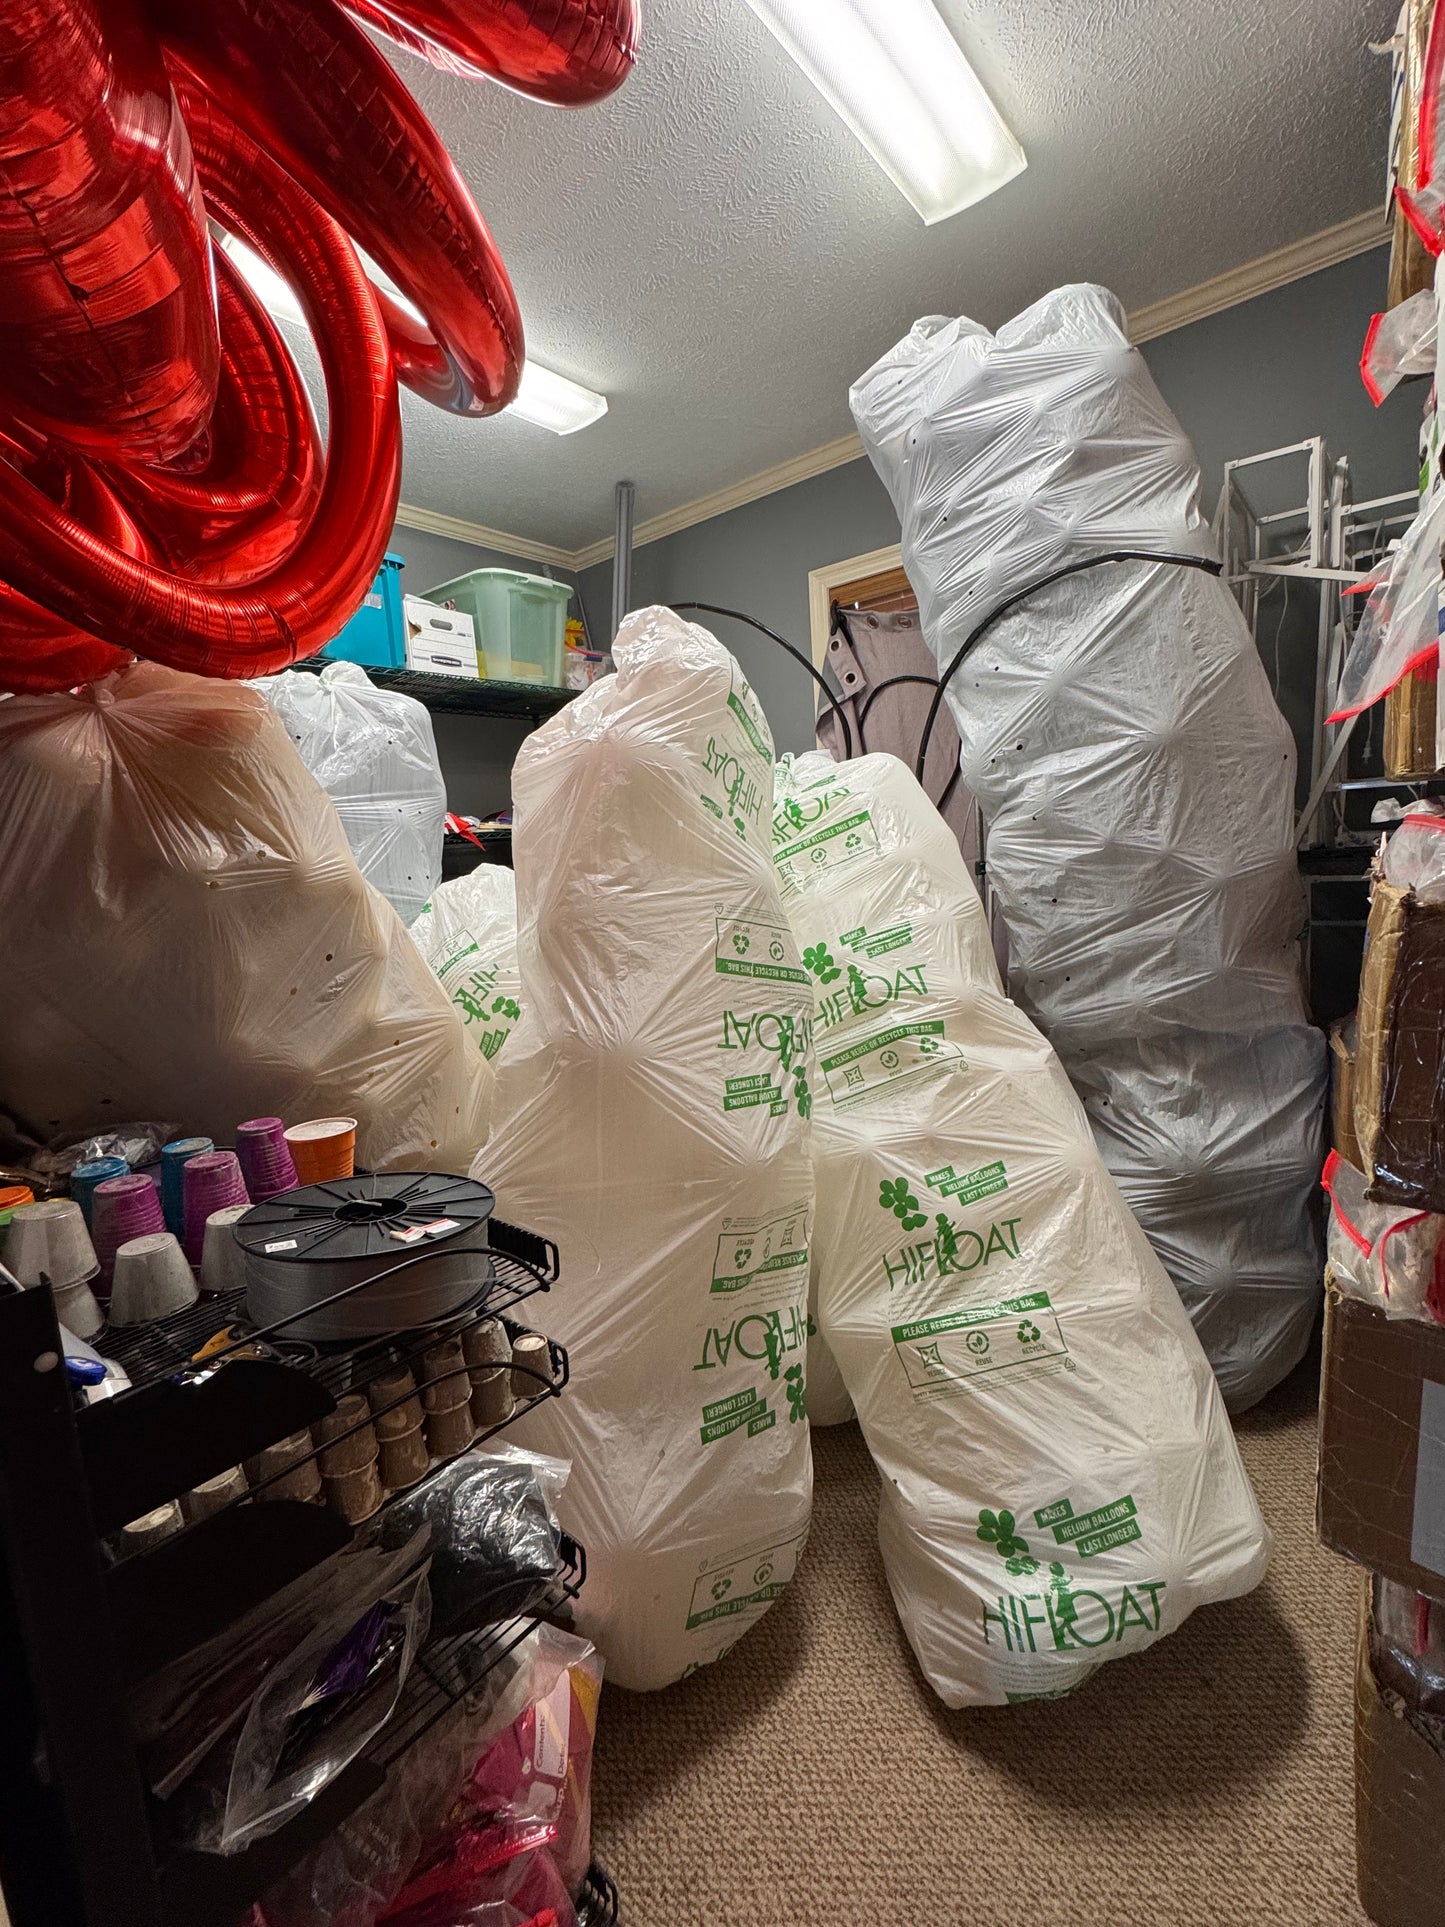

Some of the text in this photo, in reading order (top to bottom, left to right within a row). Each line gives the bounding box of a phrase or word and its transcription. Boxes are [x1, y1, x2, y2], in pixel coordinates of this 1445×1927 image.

[810, 829, 836, 844] RECYCLE
[835, 823, 848, 833] THIS
[755, 964, 779, 979] RECYCLE
[780, 969, 788, 978] OR
[830, 1053, 852, 1067] PLEASE
[850, 1045, 869, 1057] REUSE
[869, 1040, 878, 1049] OR
[877, 1028, 905, 1044] RECYCLE
[905, 1023, 920, 1036] THIS
[728, 1094, 758, 1106] BALLOONS
[929, 1171, 951, 1183] MAKES
[946, 1166, 1001, 1192] HELIUM BALLOONS
[963, 1180, 1006, 1201] LAST LONGER!
[882, 1217, 1022, 1291] HIFLOAT
[721, 1277, 738, 1290] BAG.
[902, 1324, 929, 1338] PLEASE
[1020, 1298, 1038, 1309] BAG.
[705, 1392, 753, 1418] LAST LONGER!
[705, 1416, 742, 1437] BALLOONS
[751, 1416, 773, 1431] MAKES
[1040, 1504, 1067, 1522] MAKES
[1061, 1503, 1130, 1538] HELIUM BALLOONS
[1083, 1526, 1137, 1554] LAST LONGER!
[979, 1581, 1167, 1652] HIFLOAT
